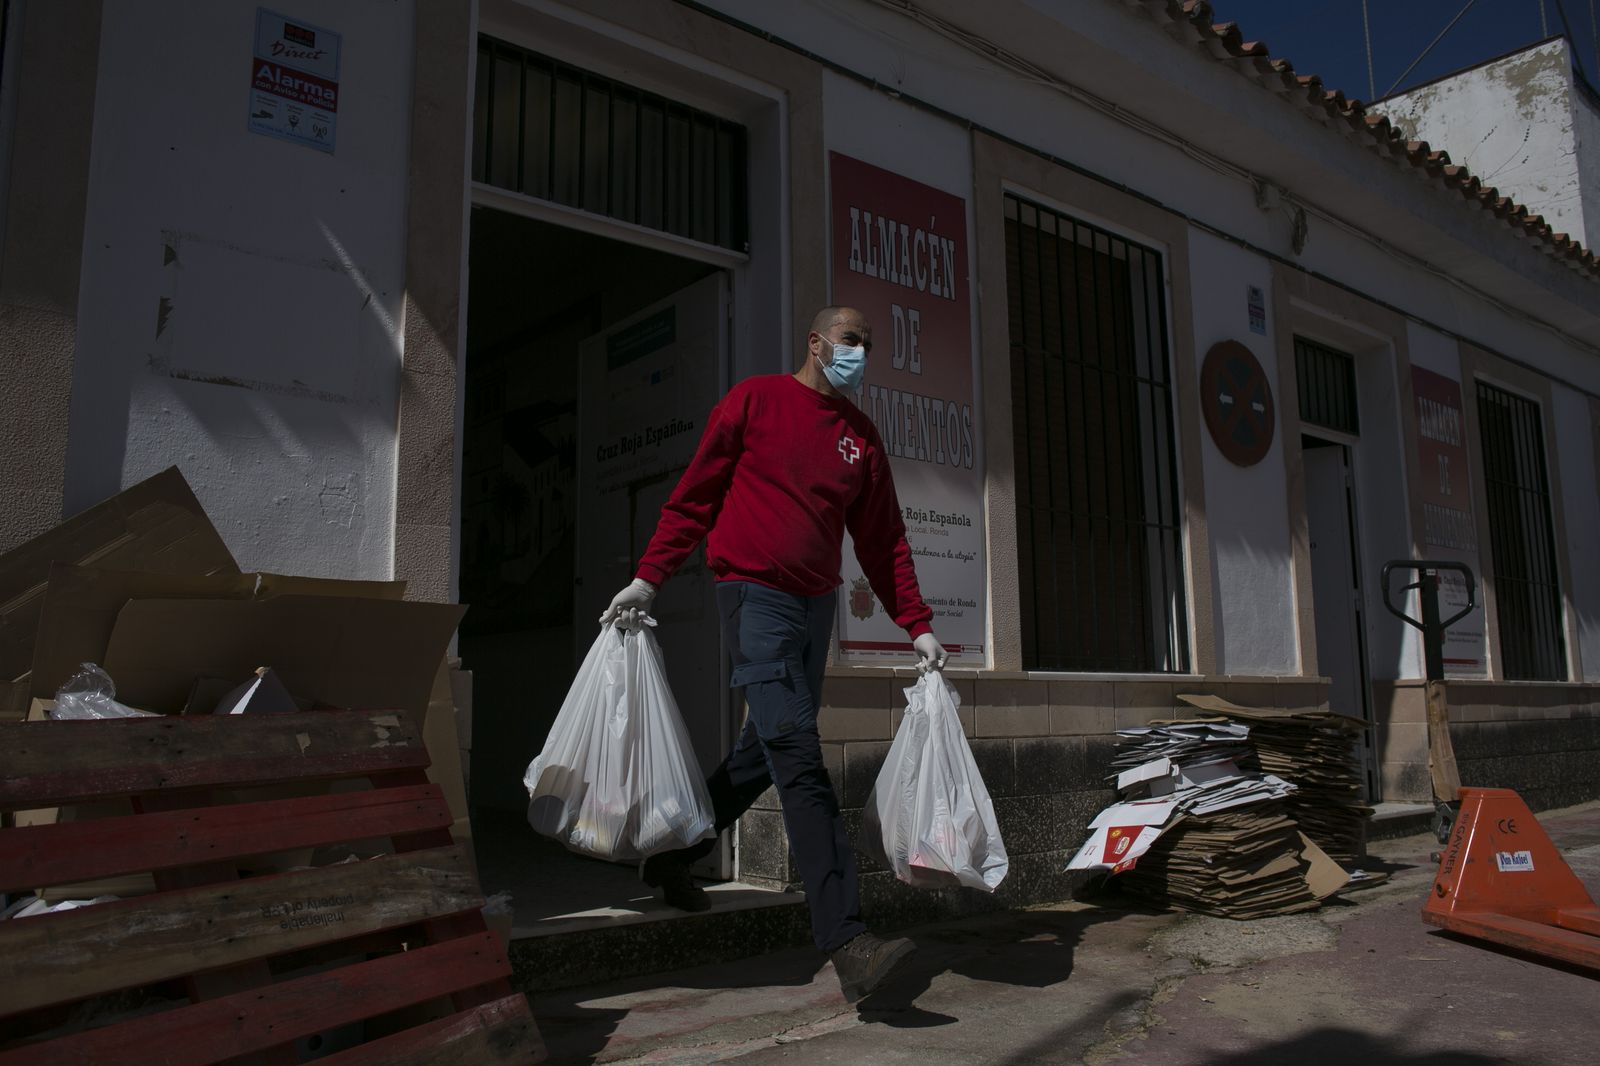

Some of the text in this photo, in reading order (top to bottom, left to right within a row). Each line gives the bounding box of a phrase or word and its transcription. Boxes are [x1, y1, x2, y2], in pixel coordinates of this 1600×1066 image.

[269, 40, 328, 60] Direct
[256, 64, 336, 101] Alarma
[848, 205, 956, 301] ALMACÉN
[890, 304, 922, 376] DE
[856, 383, 974, 470] IMENTOS
[596, 443, 618, 463] Cruz
[620, 431, 643, 455] Roja
[905, 506, 928, 524] Roja
[929, 510, 971, 527] Española
[948, 598, 956, 607] de
[957, 598, 977, 608] Ronda
[1443, 823, 1466, 875] GAYNER
